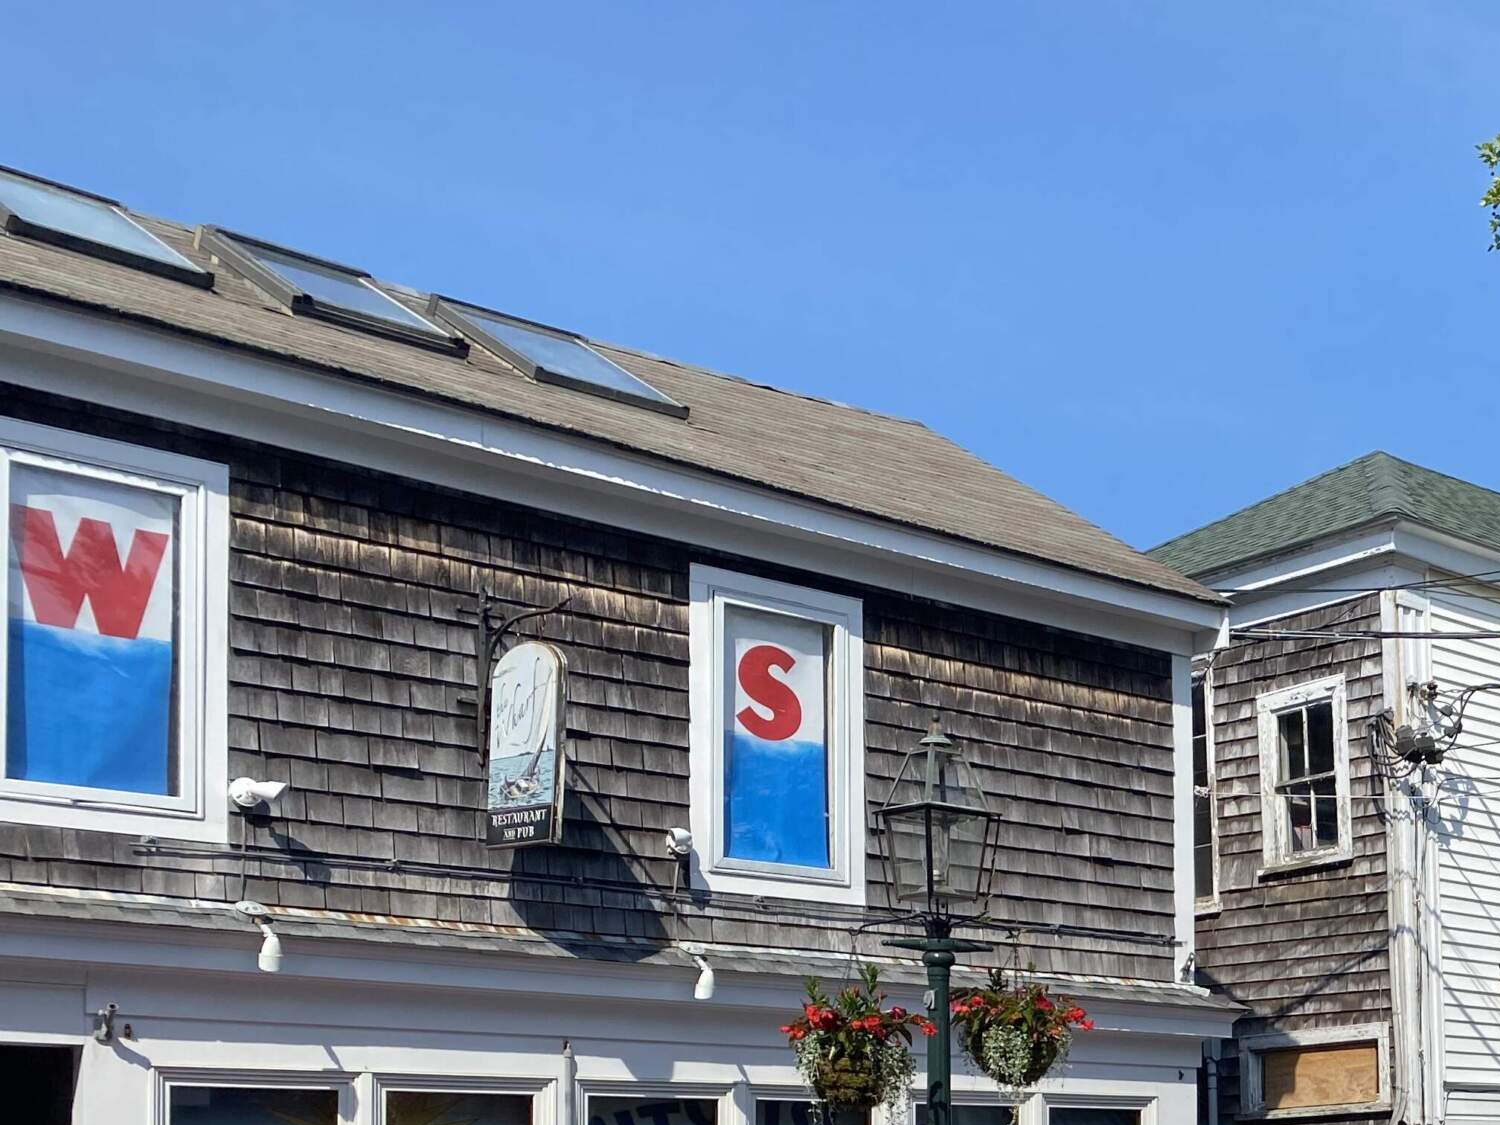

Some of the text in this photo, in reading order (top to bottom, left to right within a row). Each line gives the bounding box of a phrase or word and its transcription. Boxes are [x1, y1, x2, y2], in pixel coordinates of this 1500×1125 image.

[10, 503, 170, 640] W
[736, 645, 802, 741] S
[491, 808, 548, 827] RESTAURANT
[516, 826, 535, 839] PUB
